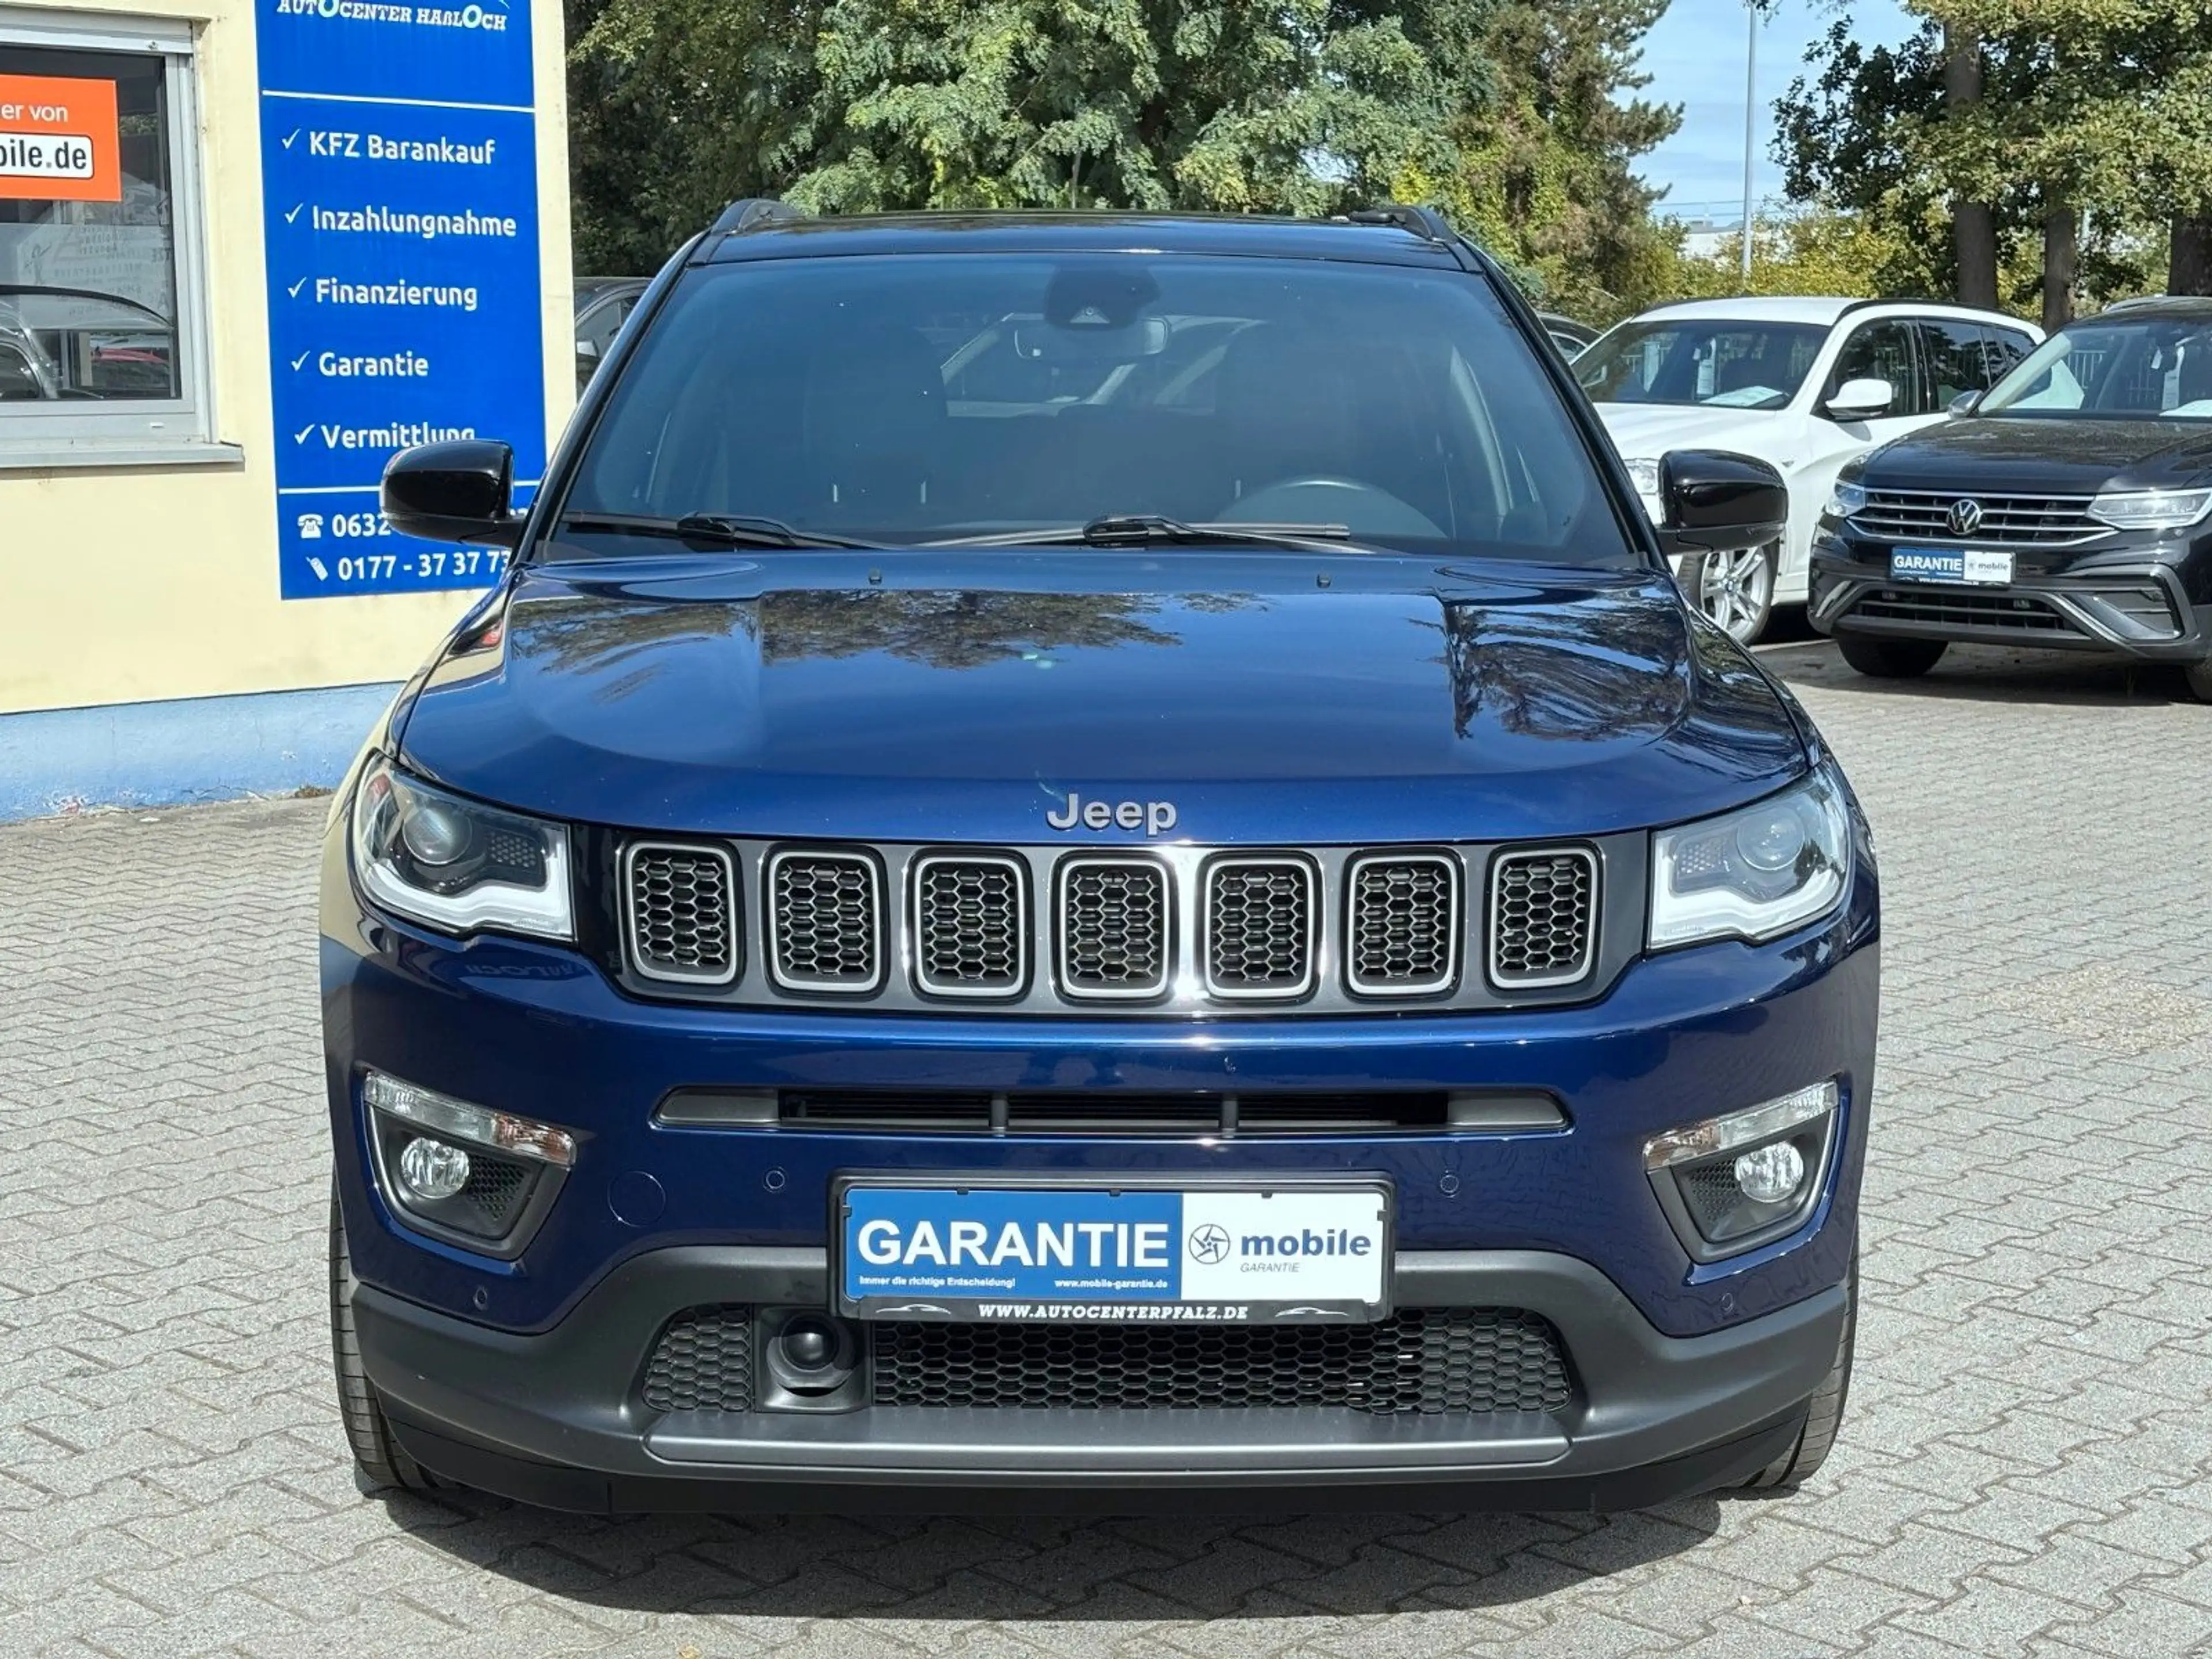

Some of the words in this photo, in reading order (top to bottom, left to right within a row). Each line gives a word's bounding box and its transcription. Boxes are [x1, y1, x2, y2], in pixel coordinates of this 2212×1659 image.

[29, 105, 69, 122] von
[309, 131, 360, 158] KFZ
[368, 135, 496, 165] Barankauf
[312, 206, 517, 239] Inzahlungnahme
[316, 278, 478, 311] Finanzierung
[319, 351, 429, 377] Garantie
[338, 556, 397, 581] 0177
[418, 554, 446, 578] 37
[453, 552, 480, 575] 37
[1893, 555, 1963, 571] GARANTIE
[1046, 793, 1177, 837] Jeep
[857, 1219, 1169, 1267] GARANTIE
[1241, 1228, 1372, 1257] mobile
[1240, 1262, 1300, 1273] GARANTIE
[859, 1275, 891, 1286] Immer
[891, 1276, 907, 1286] die
[908, 1276, 946, 1289] richtige
[946, 1278, 1016, 1290] Entscheidung!
[1055, 1278, 1169, 1290] www.mobile-garantie.de
[978, 1304, 1249, 1320] WWW.AUTOCENTERPFALZ.DE
